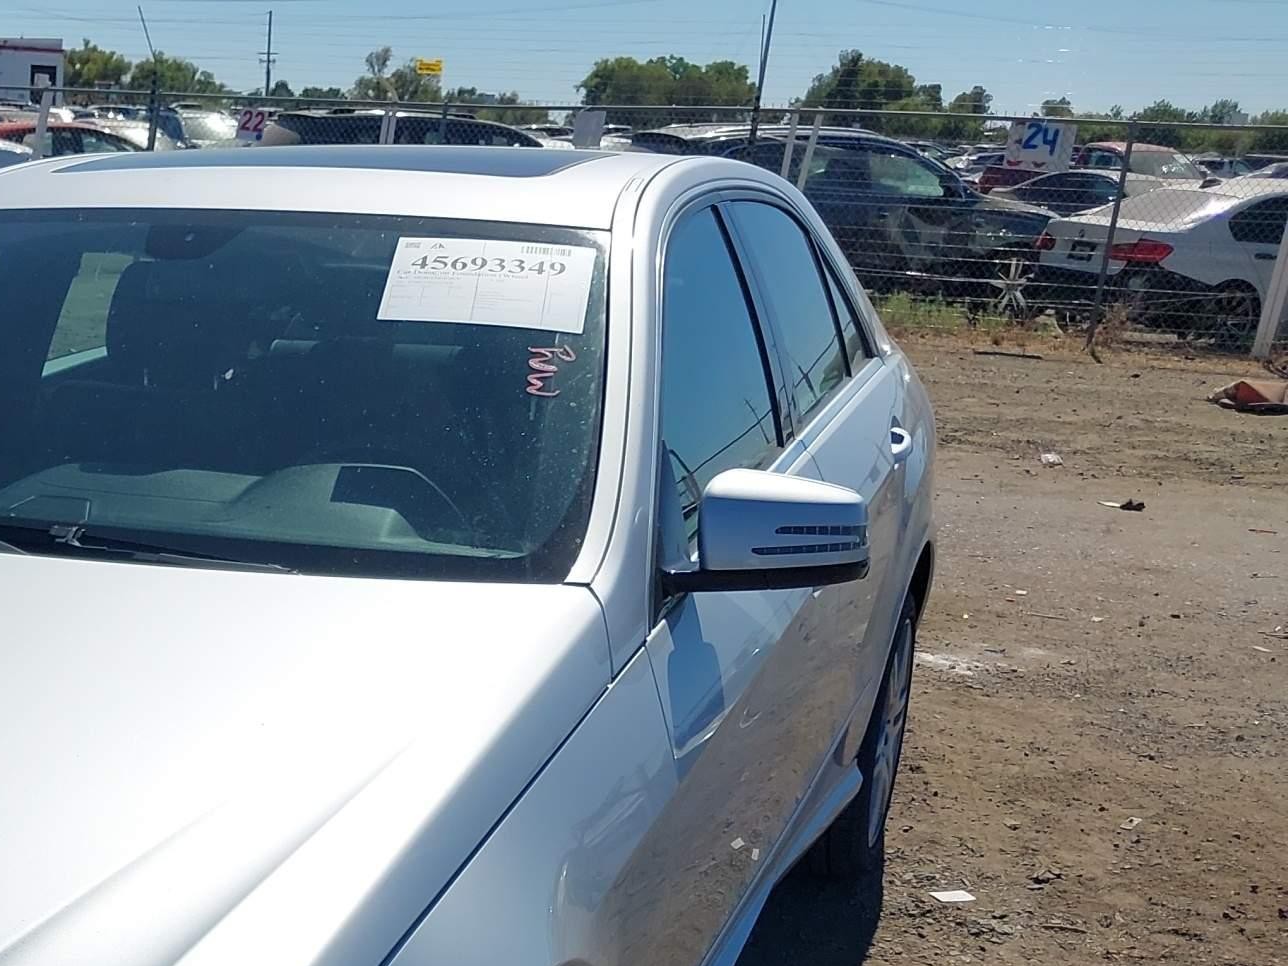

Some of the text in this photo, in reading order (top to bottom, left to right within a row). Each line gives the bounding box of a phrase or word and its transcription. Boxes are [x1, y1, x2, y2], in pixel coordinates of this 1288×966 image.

[240, 110, 265, 132] 22
[1022, 122, 1060, 156] 24
[410, 255, 567, 277] 45693349
